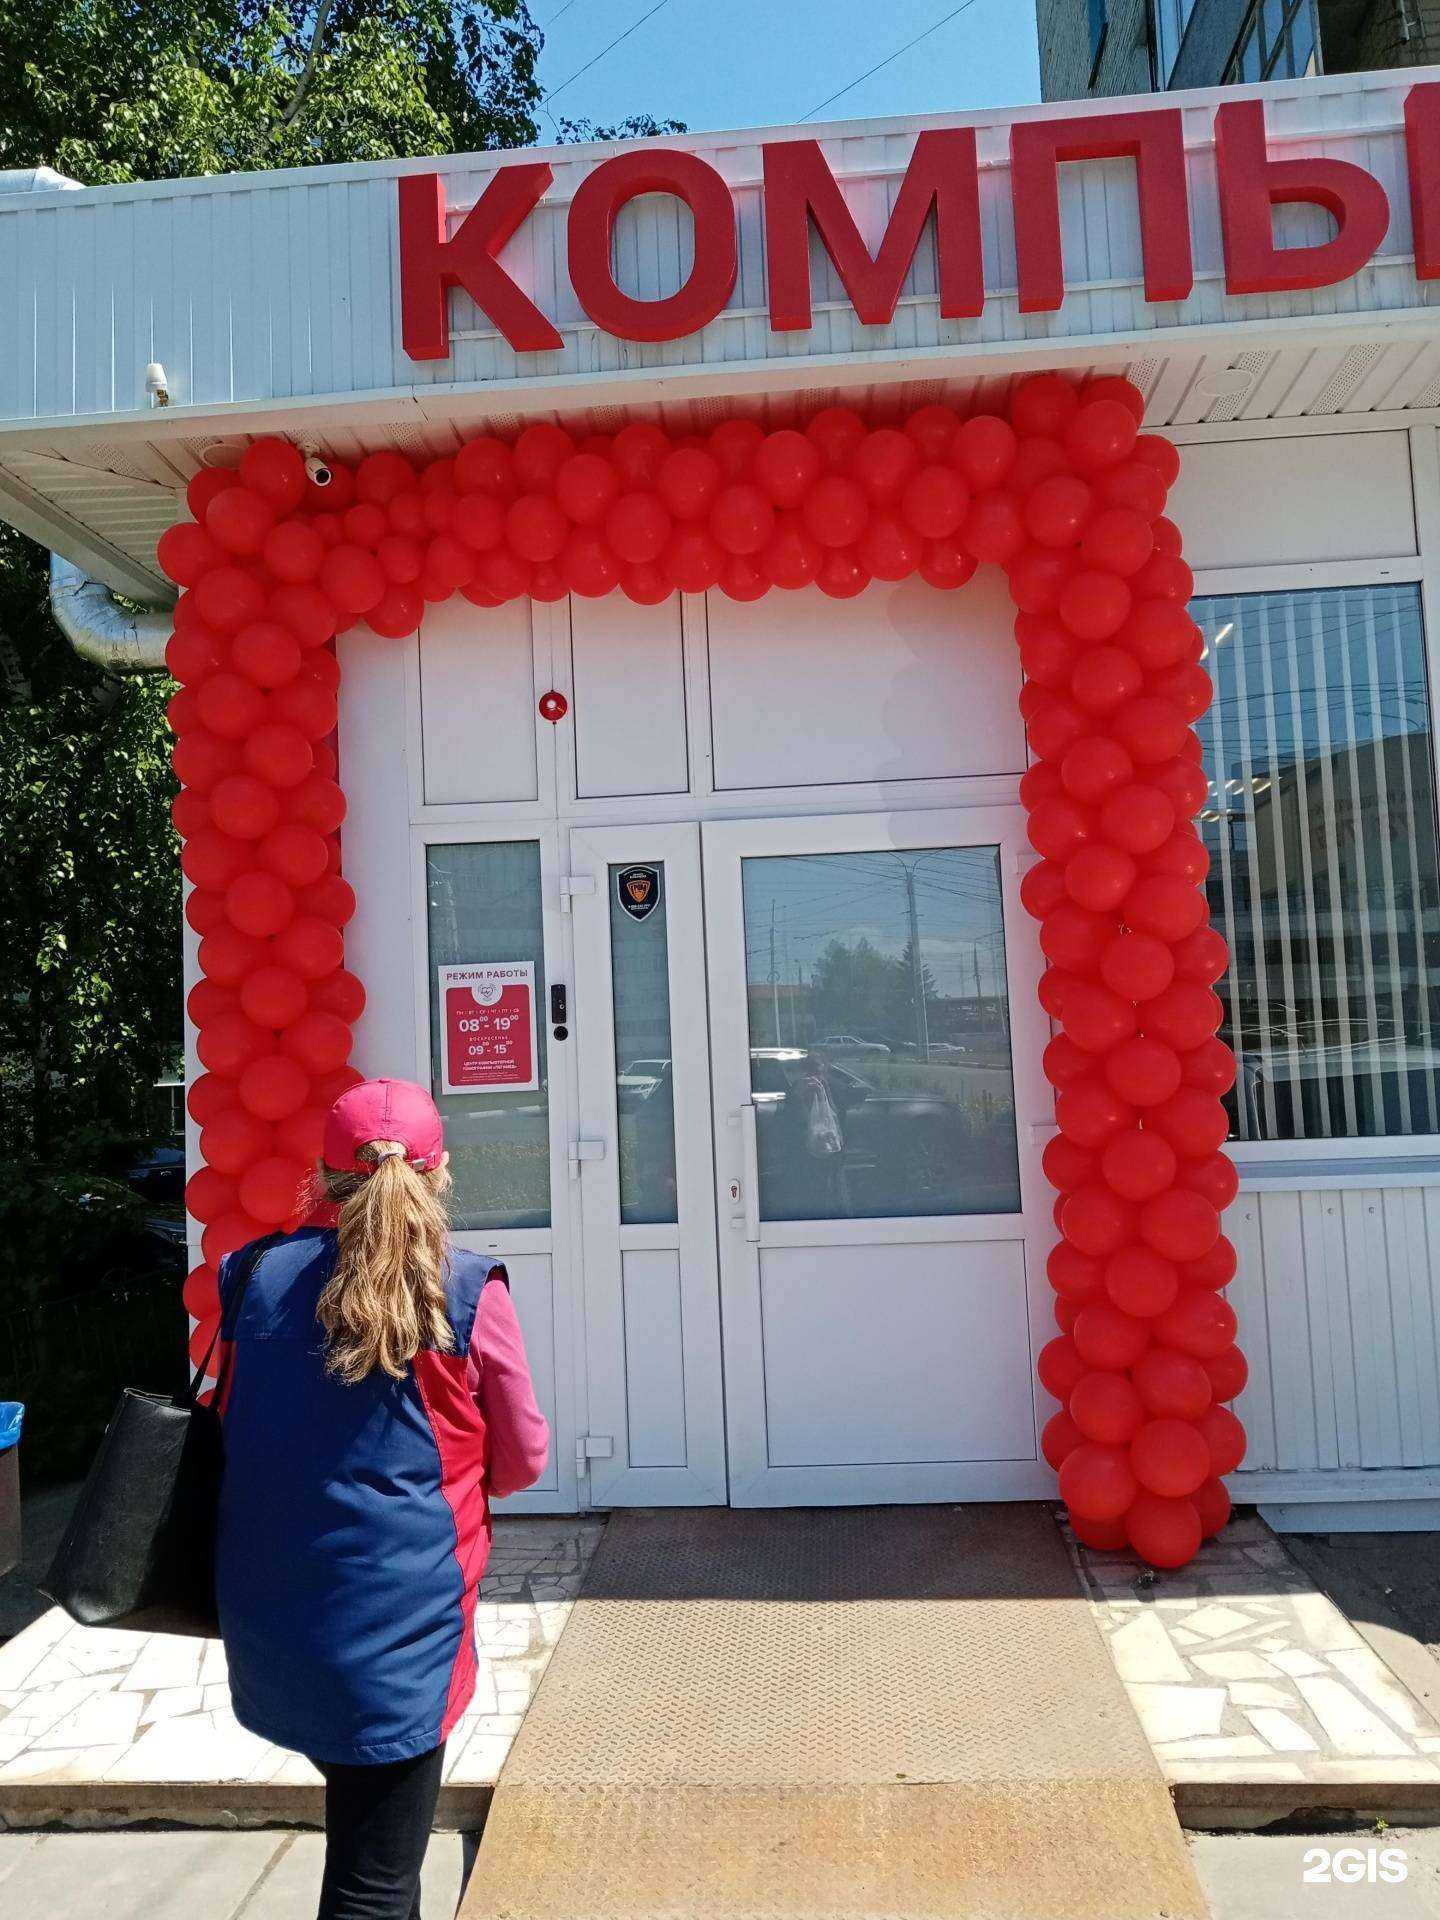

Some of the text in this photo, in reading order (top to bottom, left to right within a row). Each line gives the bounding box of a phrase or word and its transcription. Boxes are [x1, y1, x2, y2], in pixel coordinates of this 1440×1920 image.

[398, 82, 1440, 361] КОМПЬ
[446, 970, 528, 981] РЕЖИМ РАБОТЫ
